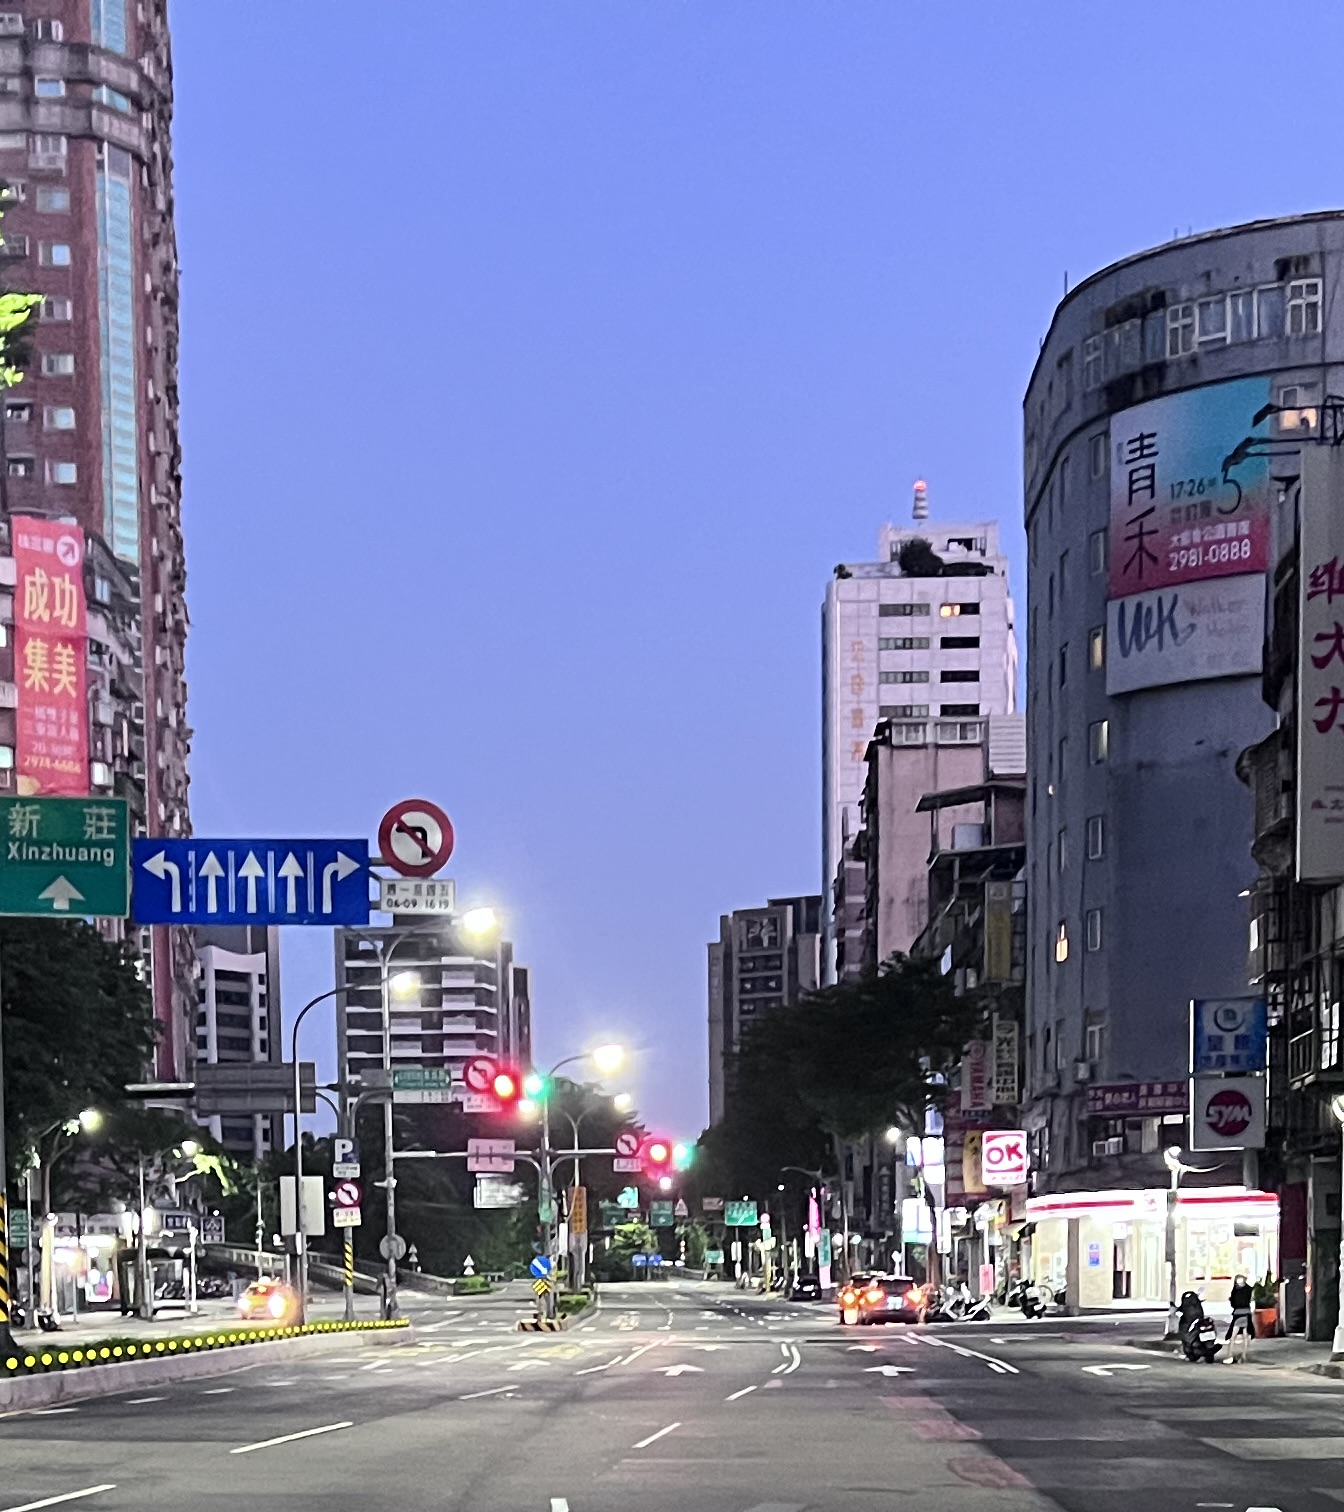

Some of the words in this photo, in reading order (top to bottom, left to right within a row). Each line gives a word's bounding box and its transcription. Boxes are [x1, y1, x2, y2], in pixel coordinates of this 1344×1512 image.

[1123, 432, 1159, 580] 青禾
[23, 566, 78, 628] 成功
[22, 637, 77, 698] 集美
[8, 802, 116, 839] 新莊
[7, 841, 115, 867] Xinzhuang
[1206, 1103, 1252, 1127] SYM
[986, 1141, 1024, 1167] OK
